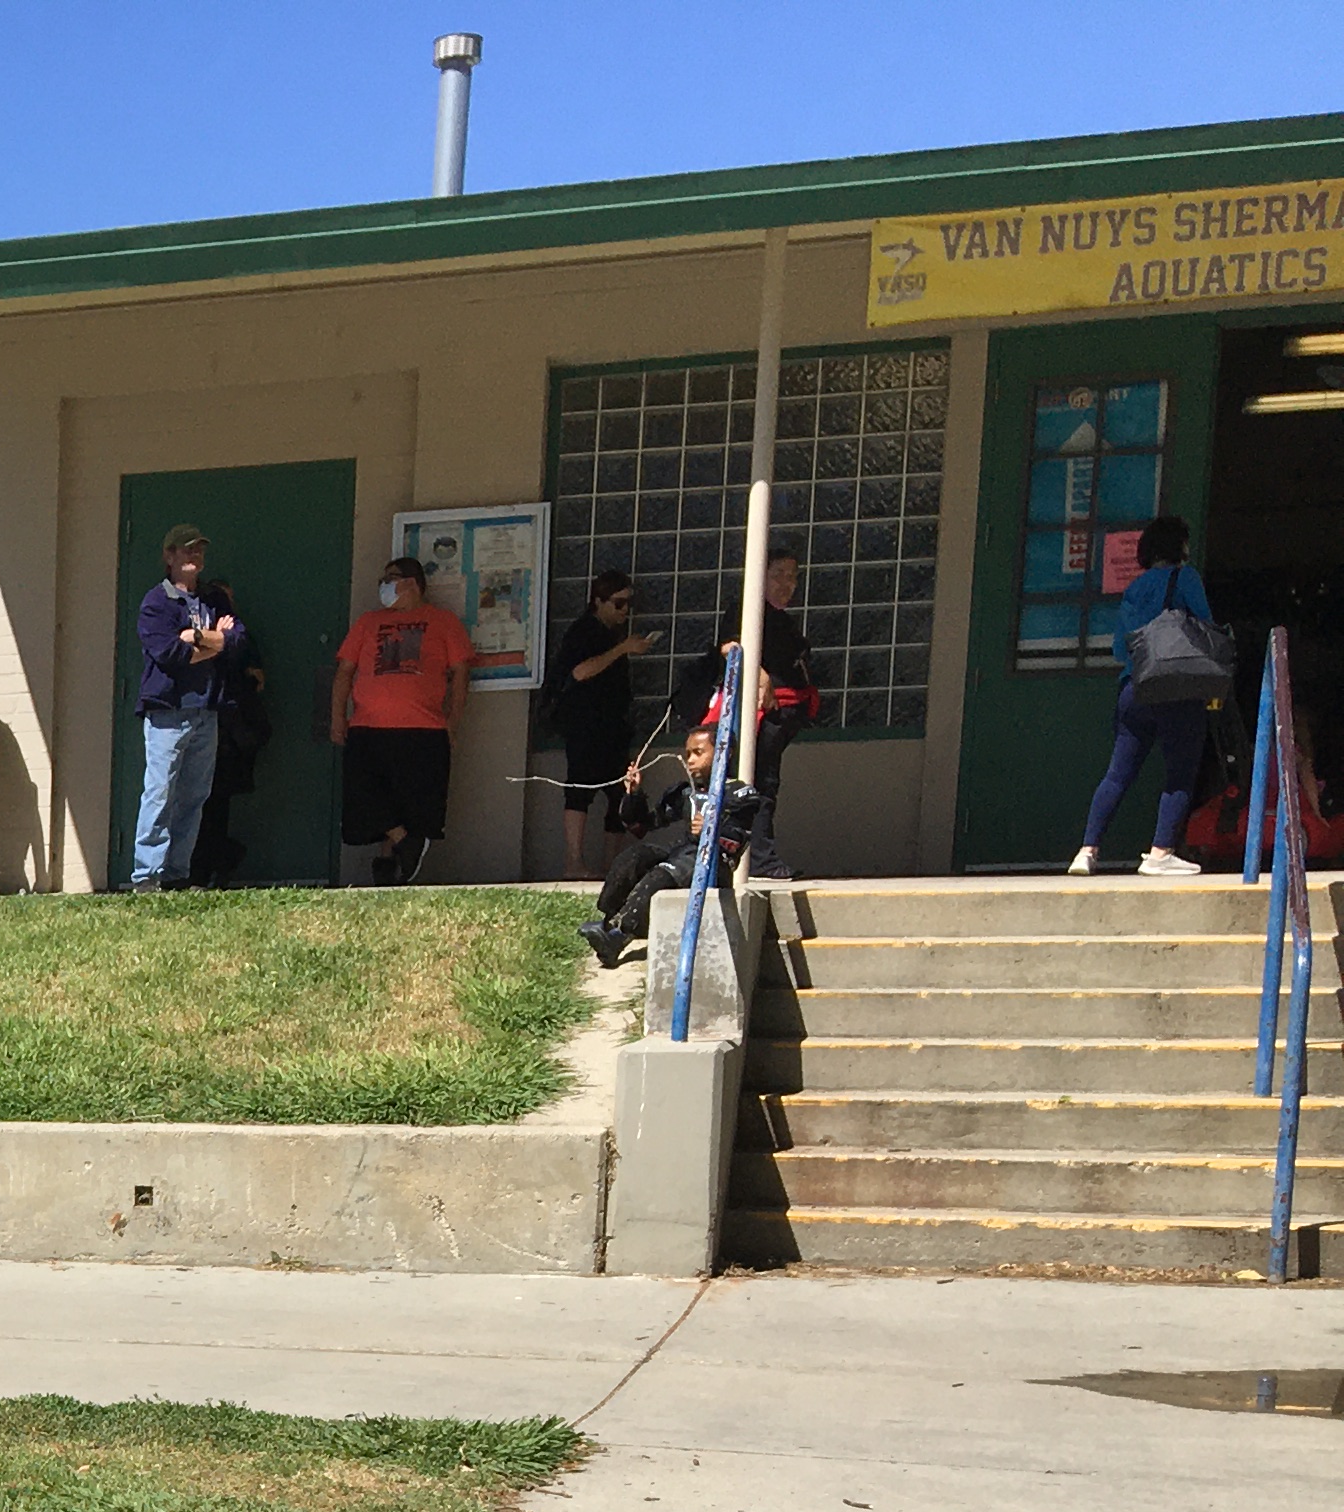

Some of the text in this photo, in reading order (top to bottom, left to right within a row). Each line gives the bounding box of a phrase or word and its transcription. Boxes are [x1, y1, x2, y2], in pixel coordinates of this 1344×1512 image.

[939, 217, 1023, 261] VAN
[1039, 206, 1158, 255] NUYS
[1109, 246, 1328, 304] AQUATICS
